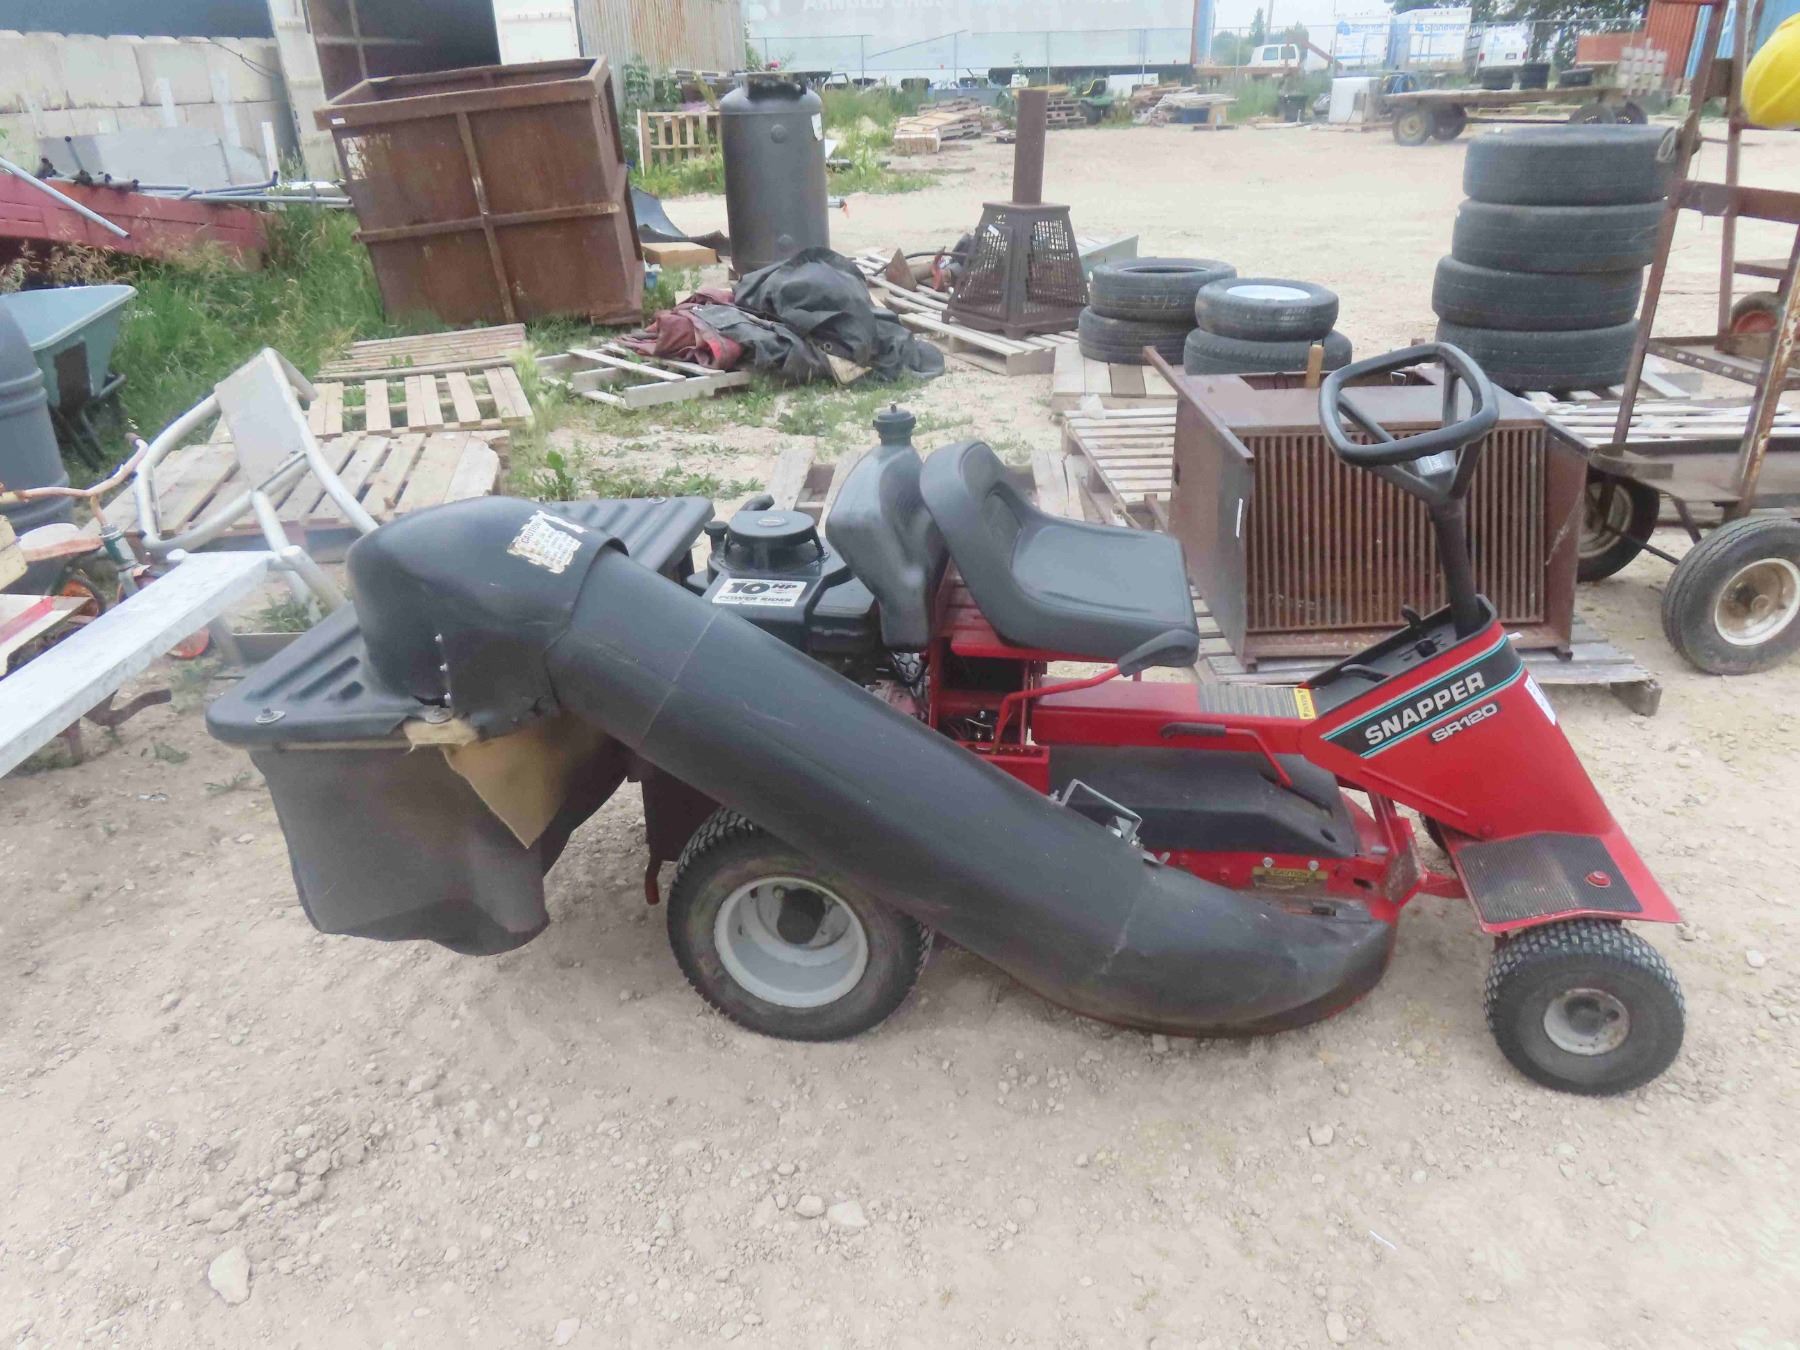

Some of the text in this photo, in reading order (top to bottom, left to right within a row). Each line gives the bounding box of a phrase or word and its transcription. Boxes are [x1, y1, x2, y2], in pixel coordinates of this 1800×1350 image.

[727, 582, 770, 594] 10
[1364, 671, 1486, 746] SNAPPER
[1431, 703, 1499, 743] SR120
